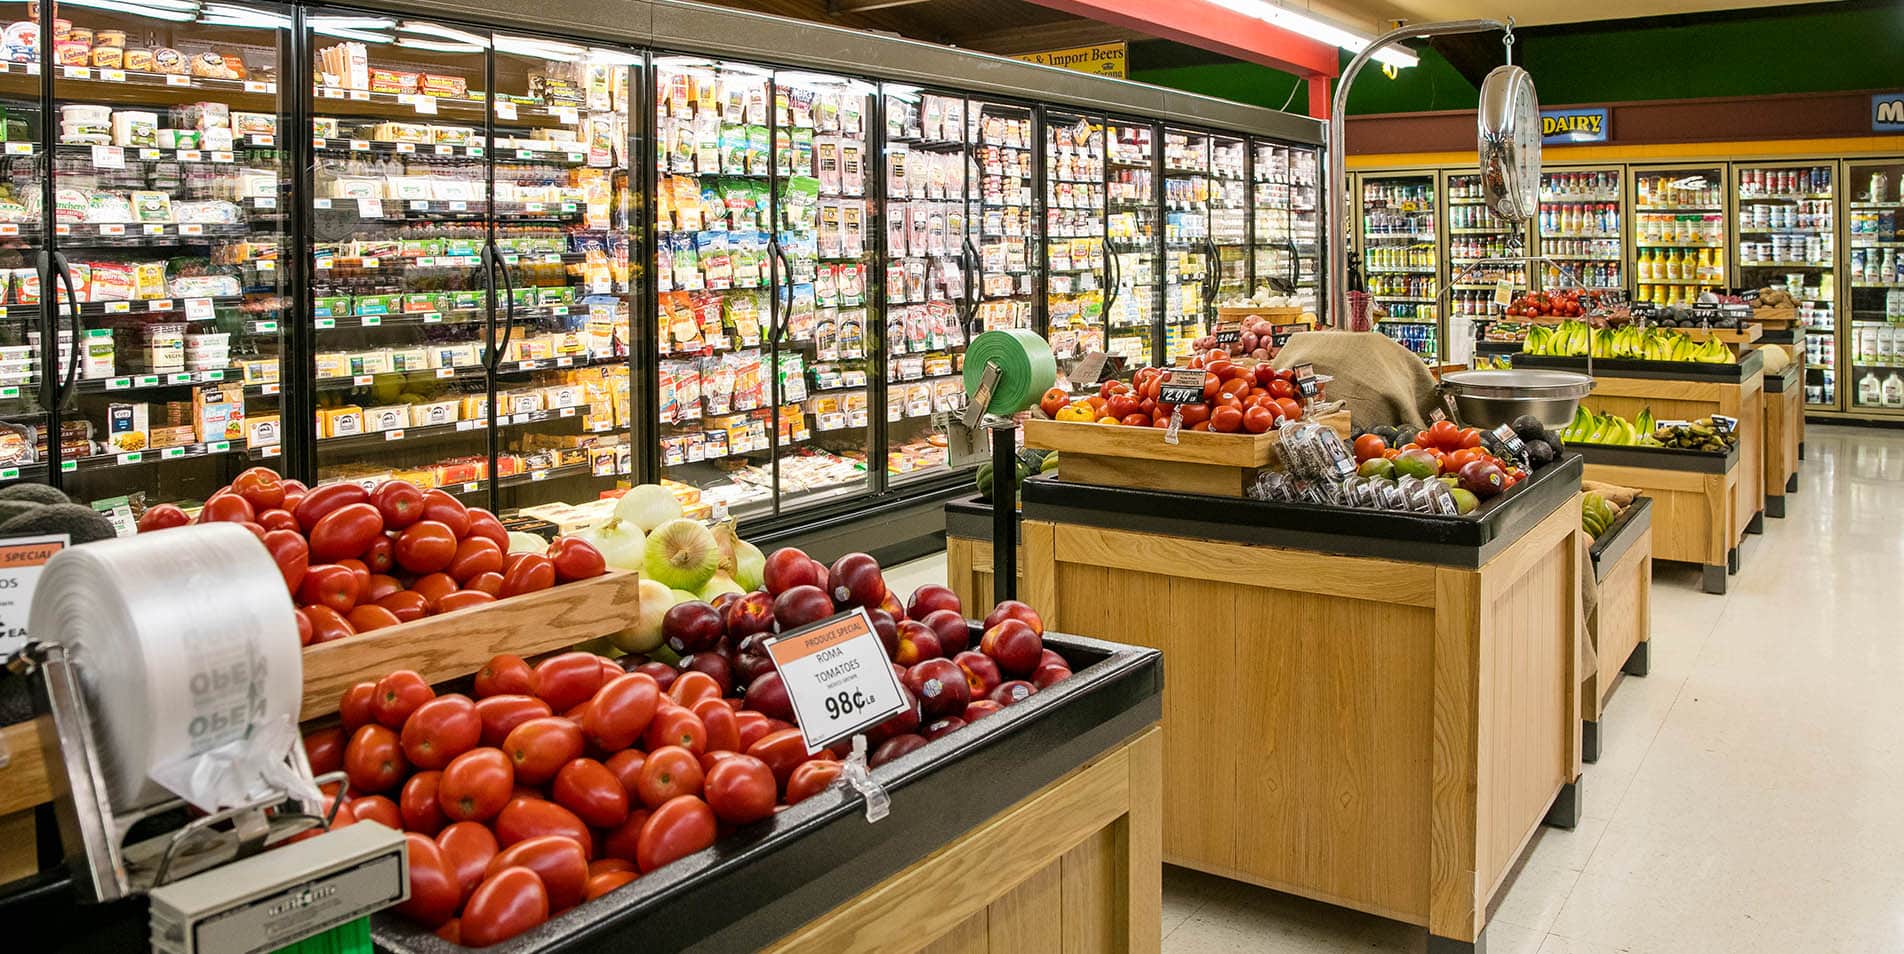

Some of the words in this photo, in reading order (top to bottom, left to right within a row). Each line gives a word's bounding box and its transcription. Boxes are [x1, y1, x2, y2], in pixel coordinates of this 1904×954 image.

[1035, 55, 1044, 64] &
[1048, 51, 1088, 67] Import
[1092, 48, 1124, 61] Beers
[1542, 115, 1602, 136] DAIRY
[6, 551, 51, 562] SPECIAL
[8, 628, 27, 638] EA
[804, 631, 836, 648] PRODUCE
[837, 622, 862, 638] SPECIAL
[816, 647, 844, 663] ROMA
[814, 658, 861, 683] TOMATOES
